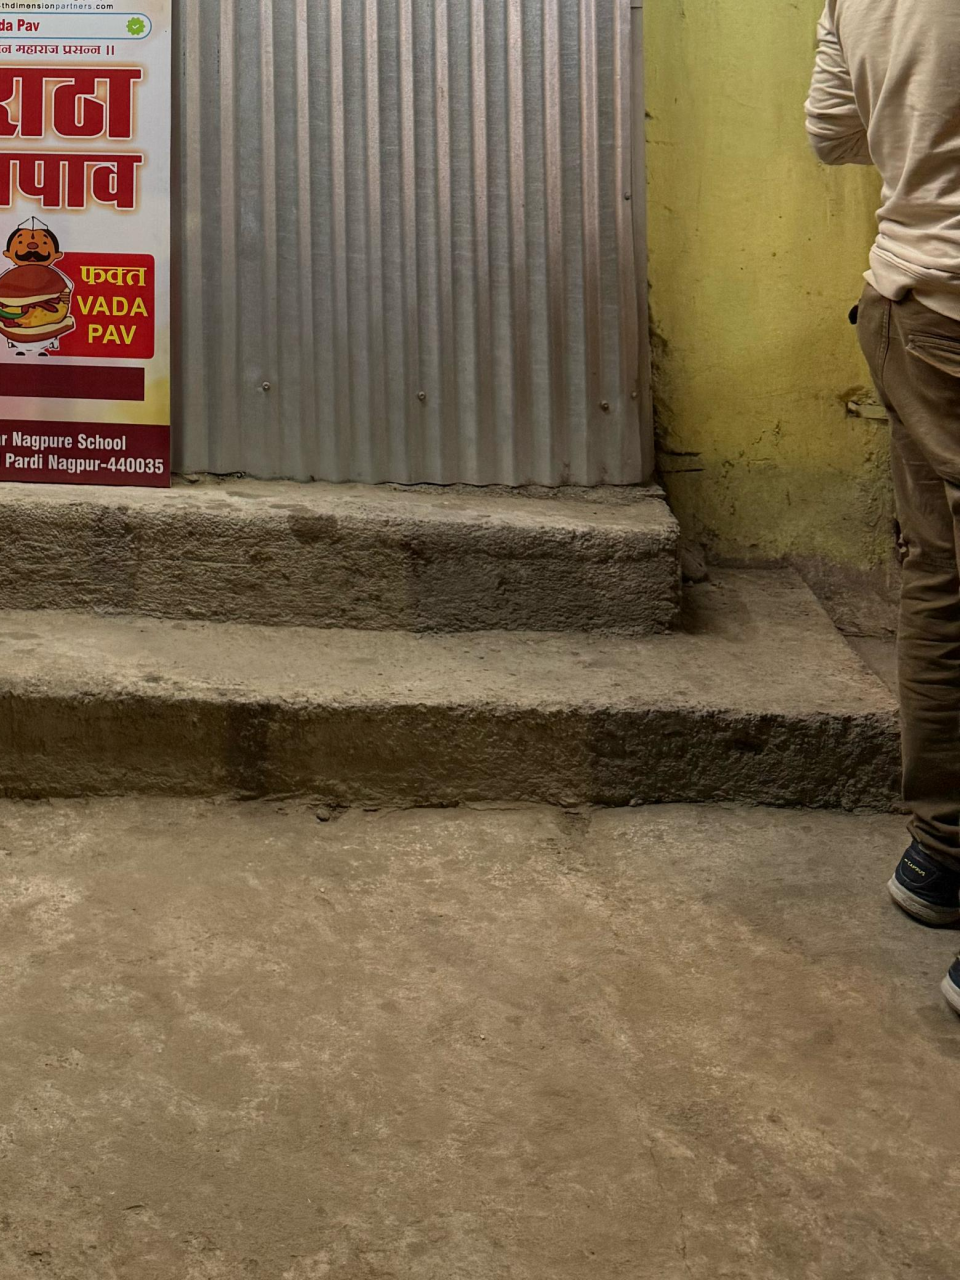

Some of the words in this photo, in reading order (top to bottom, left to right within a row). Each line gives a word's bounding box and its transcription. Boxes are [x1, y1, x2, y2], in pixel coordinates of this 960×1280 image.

[16, 18, 41, 32] Pav
[15, 44, 59, 55] महाराज
[62, 44, 102, 55] प्रसन्न
[79, 265, 148, 287] फक्त
[76, 295, 149, 317] VADA
[88, 323, 137, 345] PAV
[11, 431, 73, 451] Nagpure
[77, 433, 127, 451] School
[5, 453, 44, 469] Pardi
[48, 455, 164, 474] Nagpur-440035
